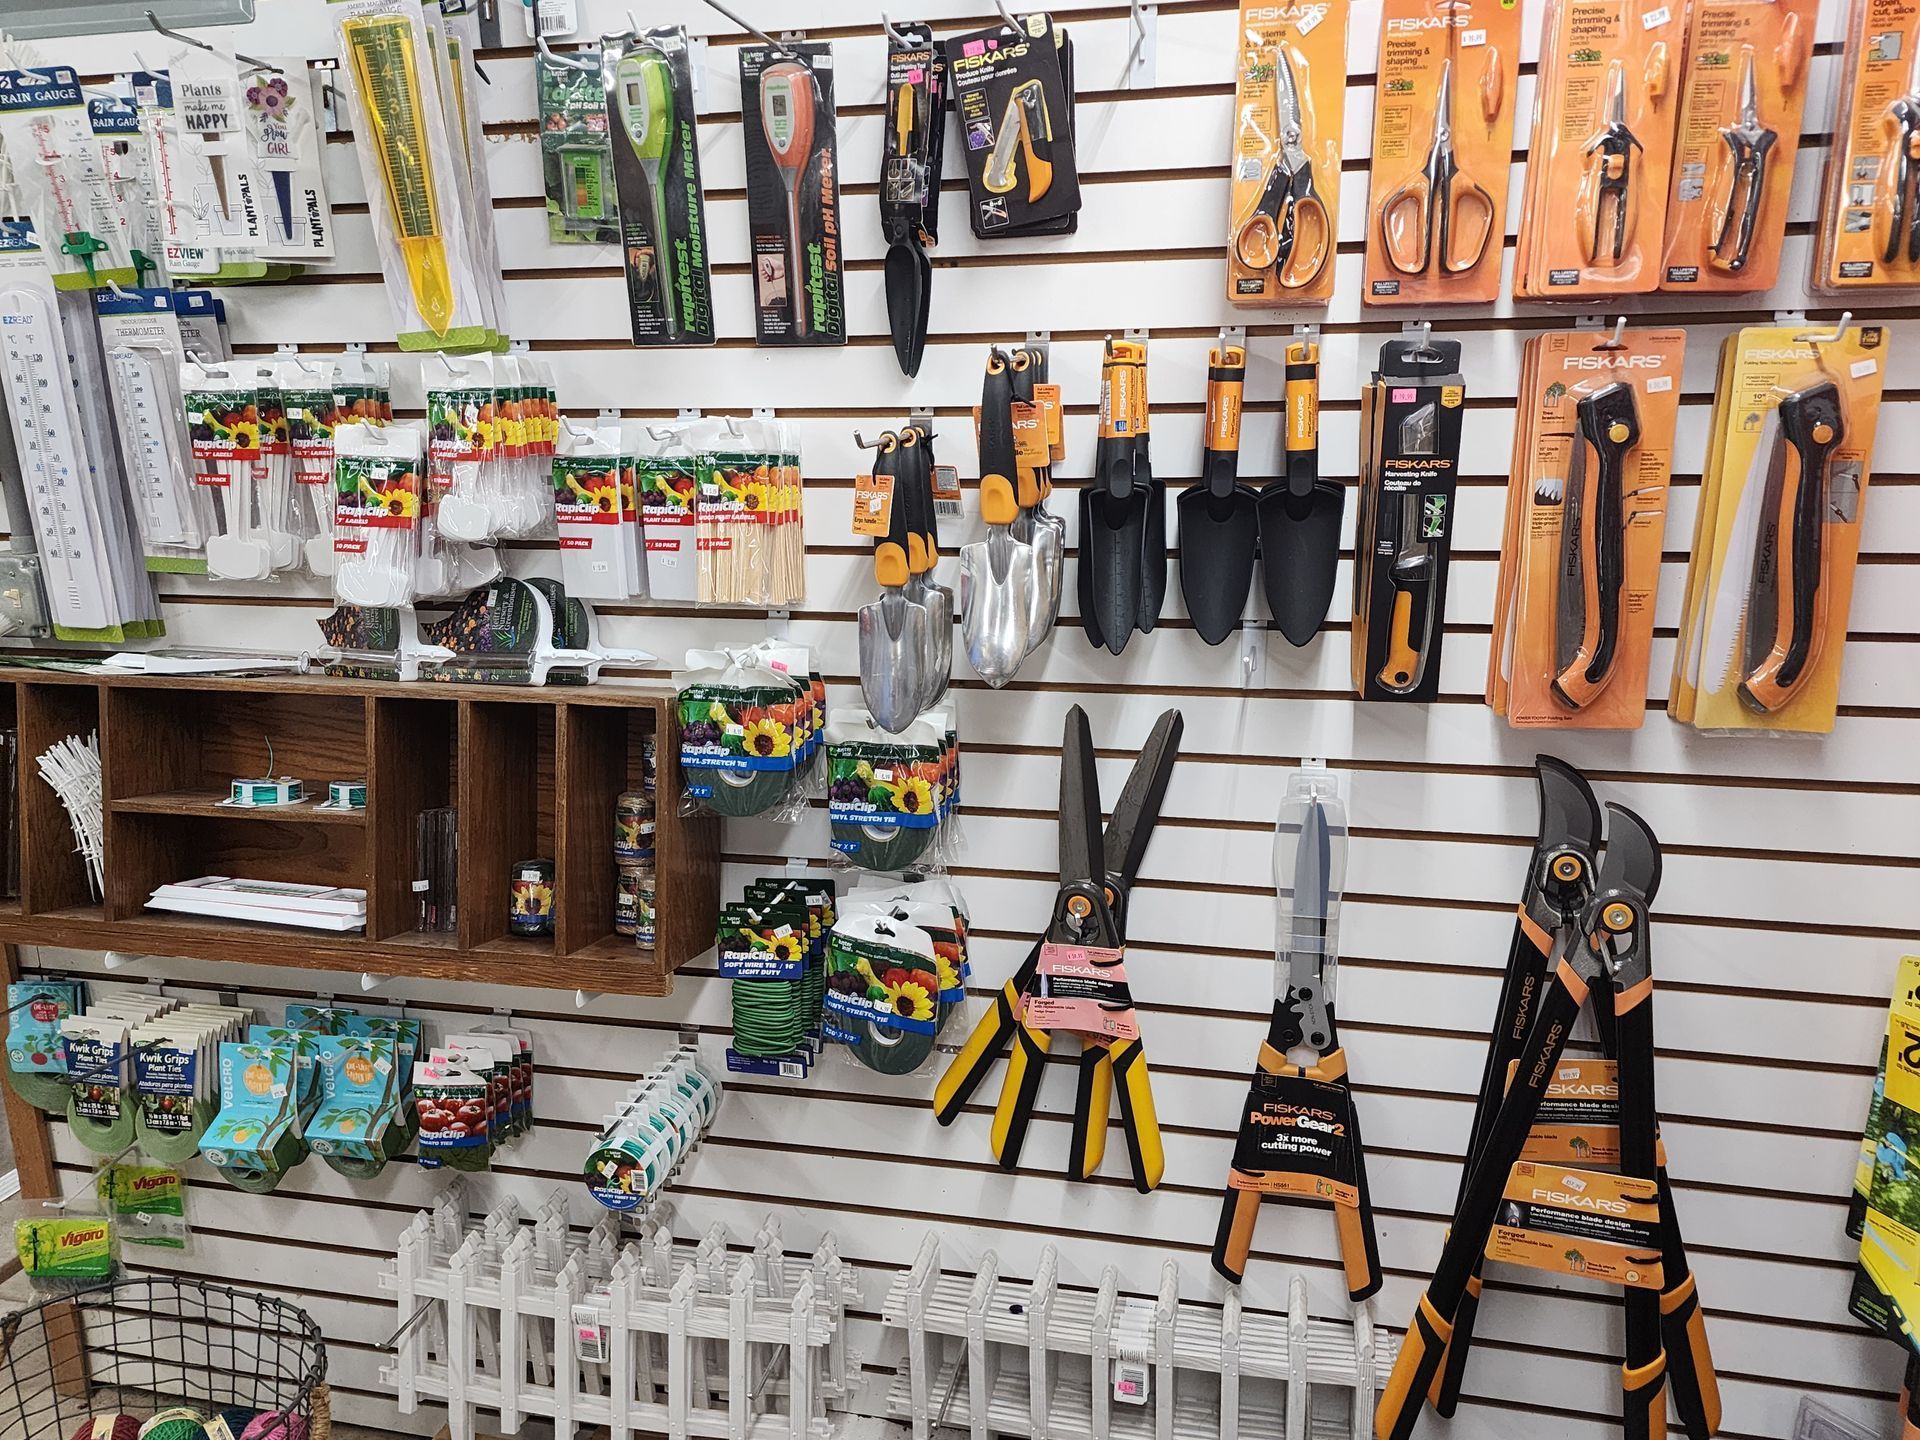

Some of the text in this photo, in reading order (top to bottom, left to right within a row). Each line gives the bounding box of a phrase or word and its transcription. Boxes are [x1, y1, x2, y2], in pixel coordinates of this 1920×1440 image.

[1572, 7, 1606, 16] Precise
[1702, 10, 1736, 19] Precise
[1873, 7, 1916, 16] cut, slice
[1387, 15, 1470, 31] FISKARS
[1572, 15, 1620, 26] trimming &
[1701, 17, 1751, 28] trimming &
[1261, 30, 1287, 38] stems
[1571, 25, 1607, 35] shaping
[1700, 28, 1737, 38] shaping
[376, 35, 387, 50] 5
[1386, 41, 1417, 49] Precise
[890, 50, 931, 64] FISKARS
[953, 43, 1029, 73] FISKARS
[1386, 48, 1422, 57] trimming
[1386, 57, 1418, 66] shaping
[381, 65, 392, 79] 4
[955, 66, 995, 80] Produce Knife
[956, 67, 1018, 87] Couteau pour données
[181, 83, 222, 97] Plants
[1, 89, 77, 105] RAIN GAUGE
[184, 100, 226, 112] make me
[388, 98, 400, 115] 3
[569, 101, 599, 110] pH Soil
[92, 118, 114, 127] RAIN
[185, 113, 229, 130] HAPPY
[267, 142, 291, 155] GIRL
[819, 148, 832, 203] Meter
[822, 204, 836, 236] pH
[680, 121, 709, 337] Digital Moisture Meter
[167, 247, 205, 260] EZVIEW
[674, 239, 696, 332] rapitest
[805, 242, 827, 333] rapitest
[823, 273, 839, 336] Digital
[2, 316, 33, 325] EZREAD
[115, 327, 166, 337] THERMOMETER
[1863, 332, 1876, 340] LIFE
[1744, 348, 1821, 360] FISKARS
[1563, 355, 1662, 370] FISKARS
[1119, 370, 1127, 418] FISKARS
[1221, 395, 1229, 438] FISKARS
[193, 438, 237, 451] RapiClip
[1385, 460, 1451, 469] FISKARS
[210, 476, 227, 484] PACK
[1383, 479, 1413, 487] Couteau
[857, 490, 890, 500] FISKARS
[336, 504, 391, 518] RapiClip
[555, 503, 600, 515] RapiClip
[642, 504, 688, 516] RapiClip
[698, 501, 745, 513] RapiClip
[657, 516, 681, 524] LABELS
[864, 516, 877, 525] handle
[343, 543, 362, 551] PACK
[1566, 516, 1582, 577] FISKARS
[1759, 522, 1774, 584] FISKARS
[681, 746, 731, 758] RapiClip
[698, 758, 748, 768] STRETCH TIE
[828, 800, 877, 813] RapiClip
[849, 814, 896, 823] STRETCH TIE
[723, 947, 775, 962] RapiClip
[764, 962, 778, 970] TIE
[1052, 964, 1110, 979] FISKARS
[760, 969, 782, 977] DUTY
[1053, 976, 1114, 990] Performance blade design
[827, 988, 873, 1009] RapiClip
[1034, 999, 1055, 1007] Forged
[828, 999, 889, 1024] VINYL STRETCH TIE
[1512, 974, 1536, 1041] FISKARS
[69, 1042, 115, 1058] Kwik Grips
[1528, 1020, 1562, 1088] FISKARS
[77, 1054, 108, 1066] Plant Ties
[139, 1052, 190, 1066] Kwik Grips
[148, 1063, 182, 1074] Plant Ties
[138, 1080, 193, 1091] Ataduras para plantas
[1262, 1103, 1334, 1122] FISKARS
[1250, 1111, 1345, 1138] PowerGear2
[440, 1140, 454, 1148] TIES
[1276, 1133, 1318, 1147] 3x more
[1261, 1141, 1333, 1157] cutting power
[132, 1174, 176, 1192] Vigoro
[1532, 1189, 1628, 1214] FISKARS
[1530, 1206, 1632, 1231] Performance blade design
[60, 1227, 104, 1248] Vigoro
[1498, 1229, 1526, 1240] Forged
[1538, 1241, 1554, 1249] blade
